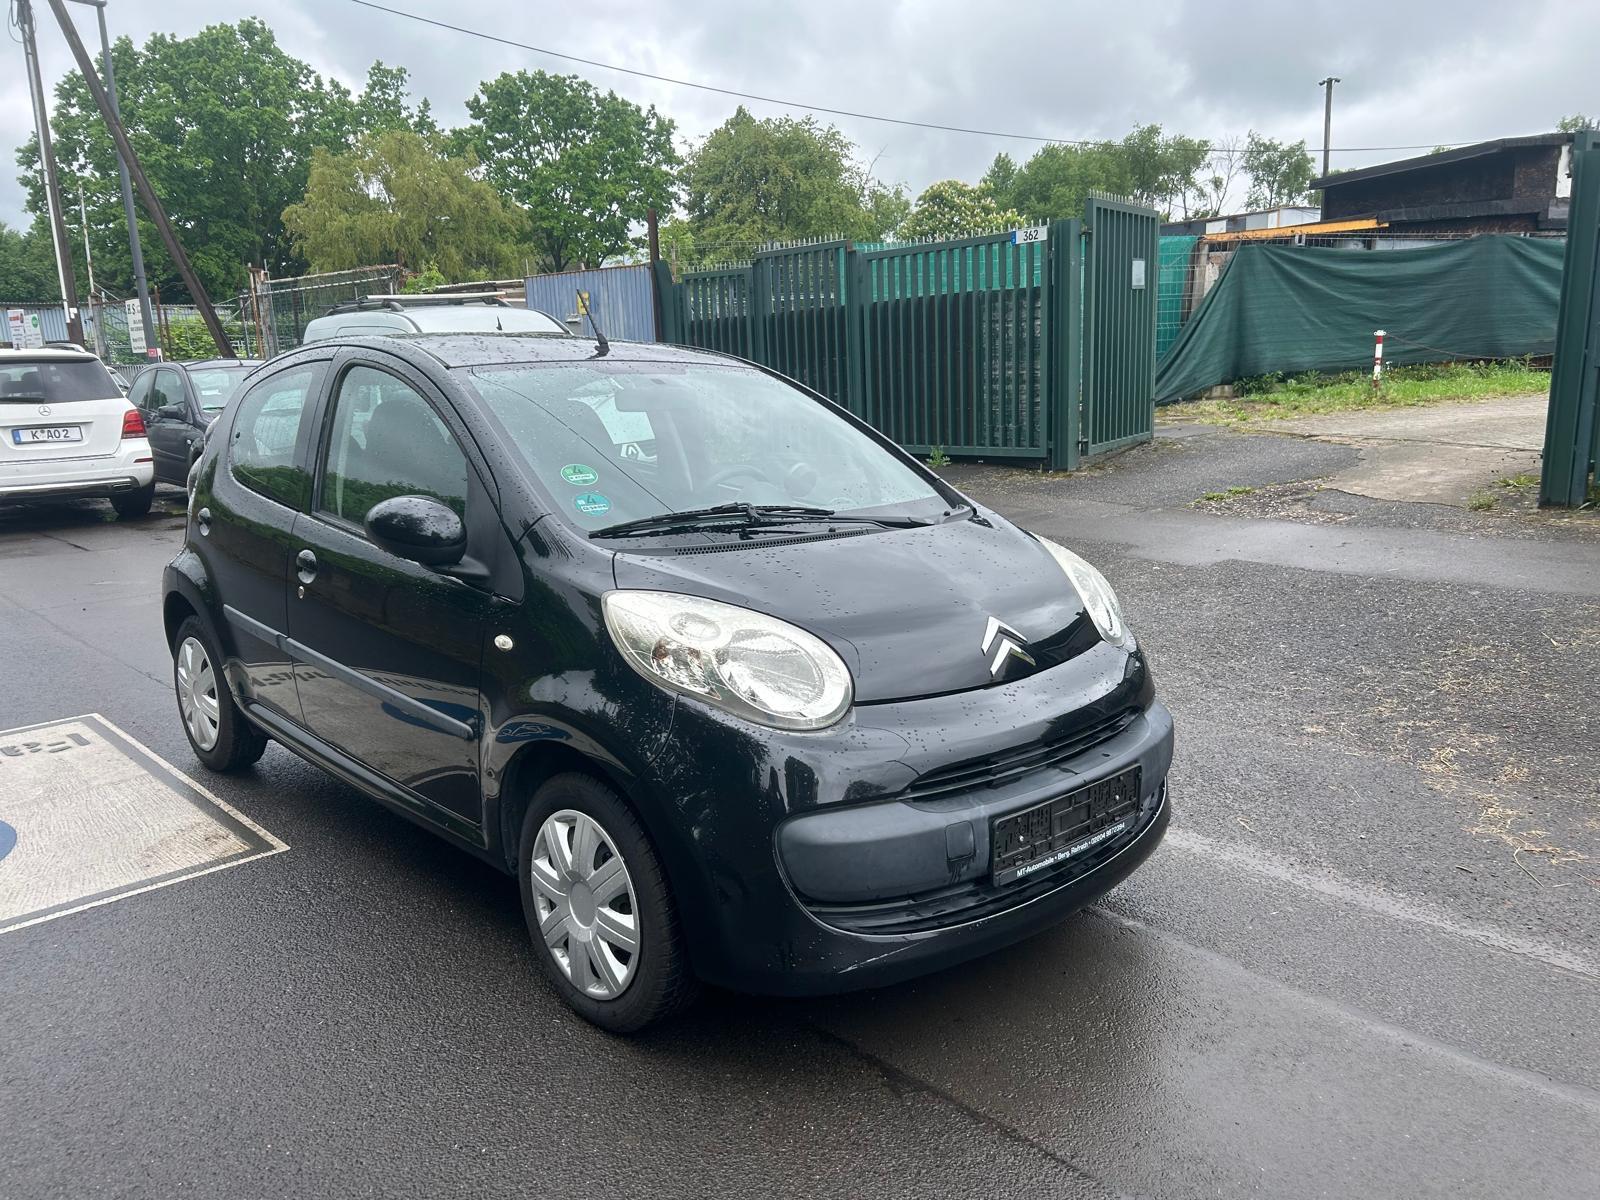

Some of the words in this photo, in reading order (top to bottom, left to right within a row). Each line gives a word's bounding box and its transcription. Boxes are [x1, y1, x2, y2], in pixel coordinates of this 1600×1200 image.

[1023, 229, 1039, 241] 362
[31, 430, 40, 440] K
[1016, 856, 1054, 877] MT-Automobile
